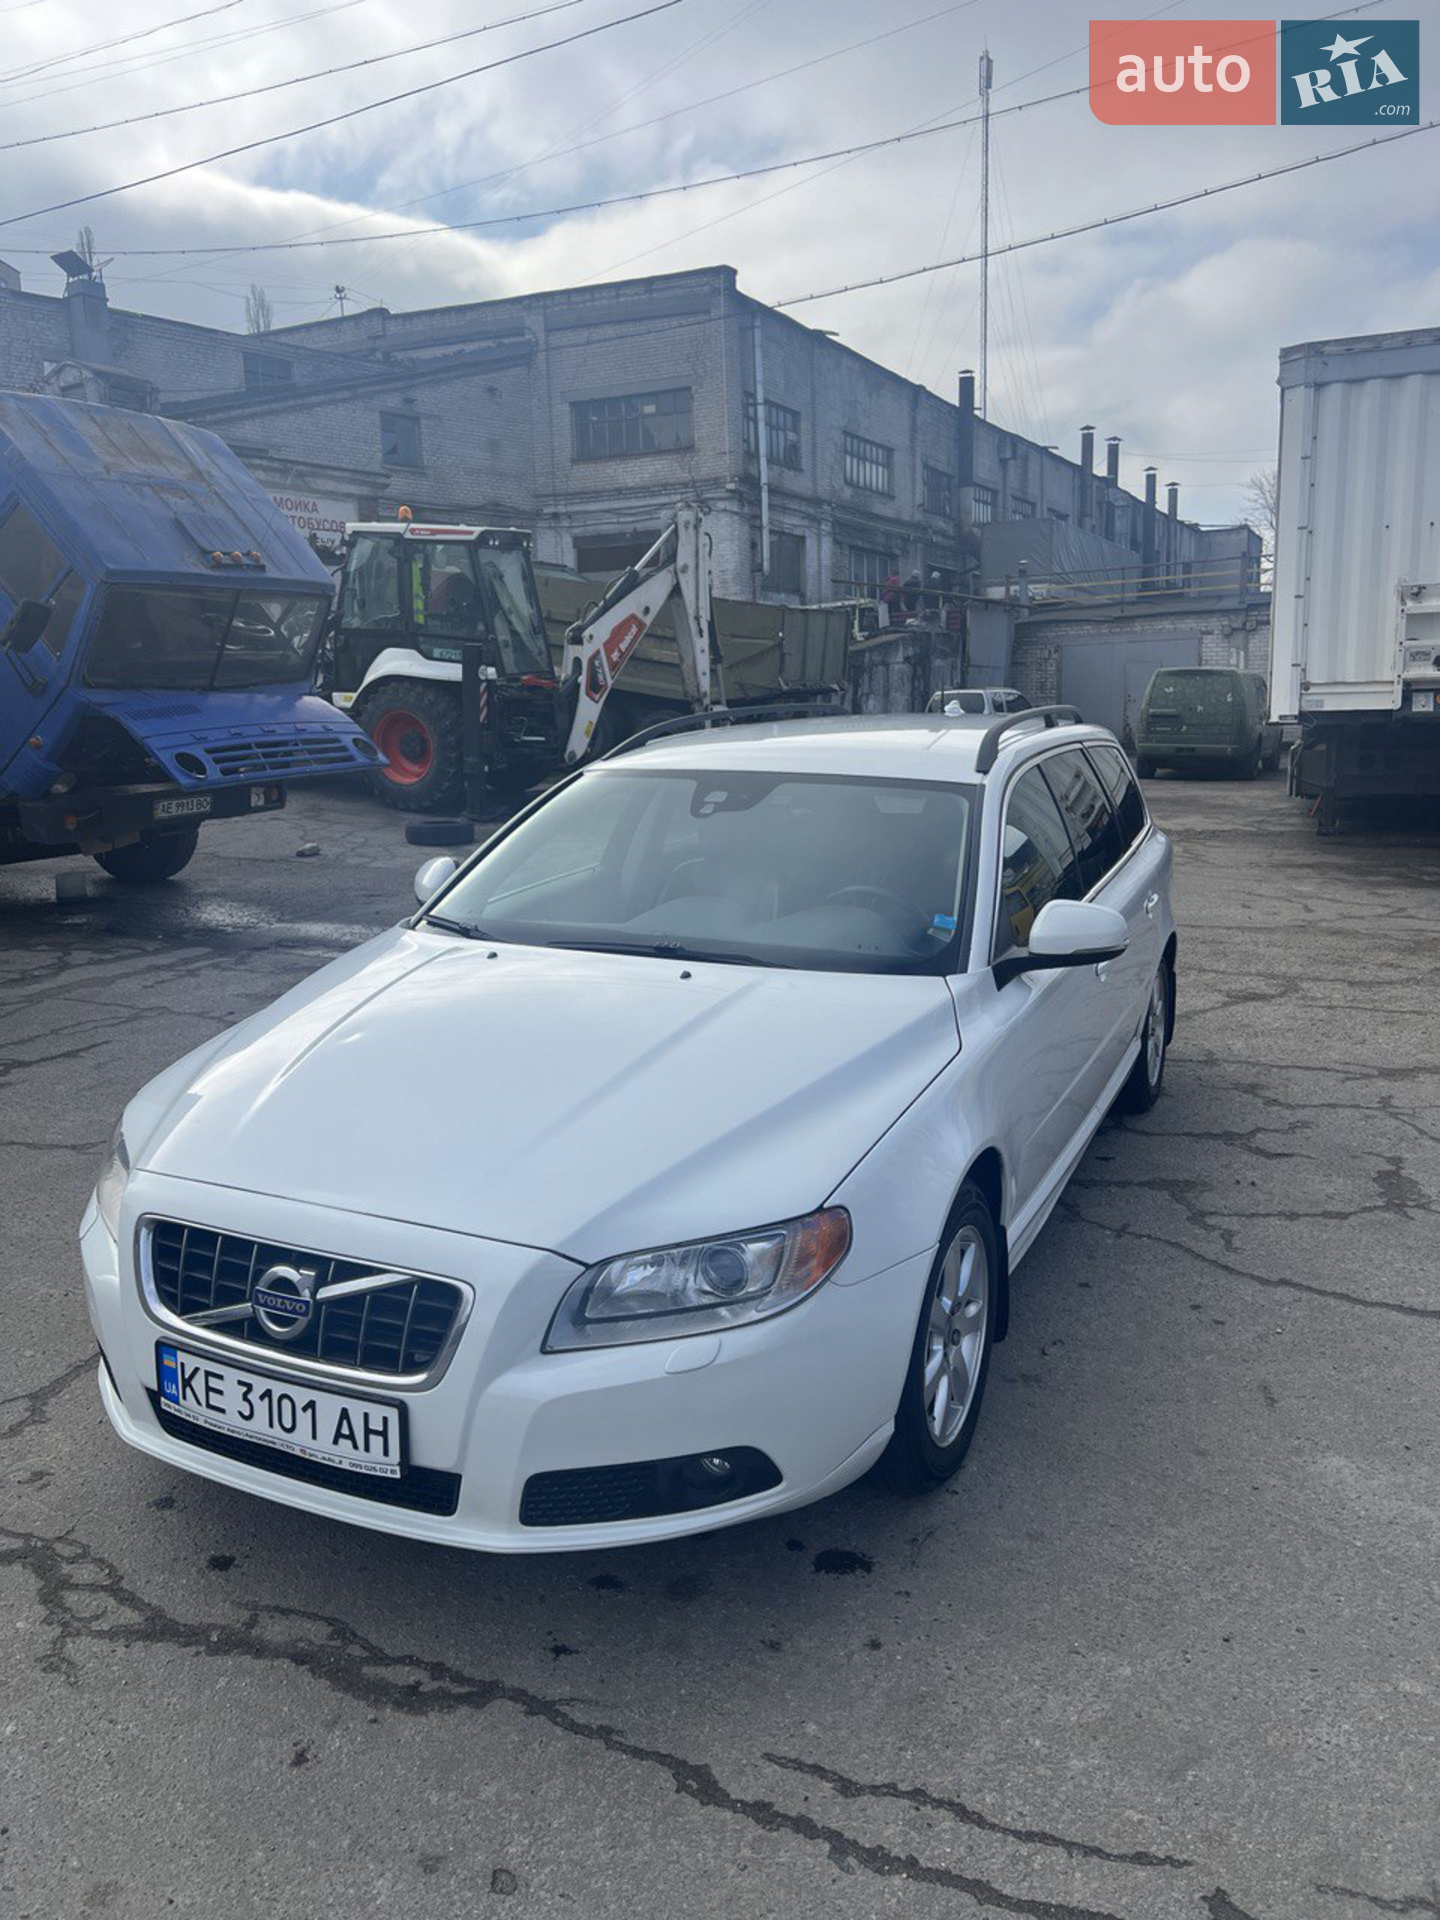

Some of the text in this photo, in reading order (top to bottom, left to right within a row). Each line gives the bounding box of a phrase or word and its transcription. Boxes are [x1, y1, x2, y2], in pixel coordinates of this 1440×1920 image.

[287, 515, 346, 533] ТОБУСОВ
[257, 1294, 307, 1313] VOLVO
[164, 1380, 178, 1396] UA
[180, 1361, 226, 1415] KE
[237, 1379, 318, 1441] 3101
[332, 1406, 390, 1458] AH
